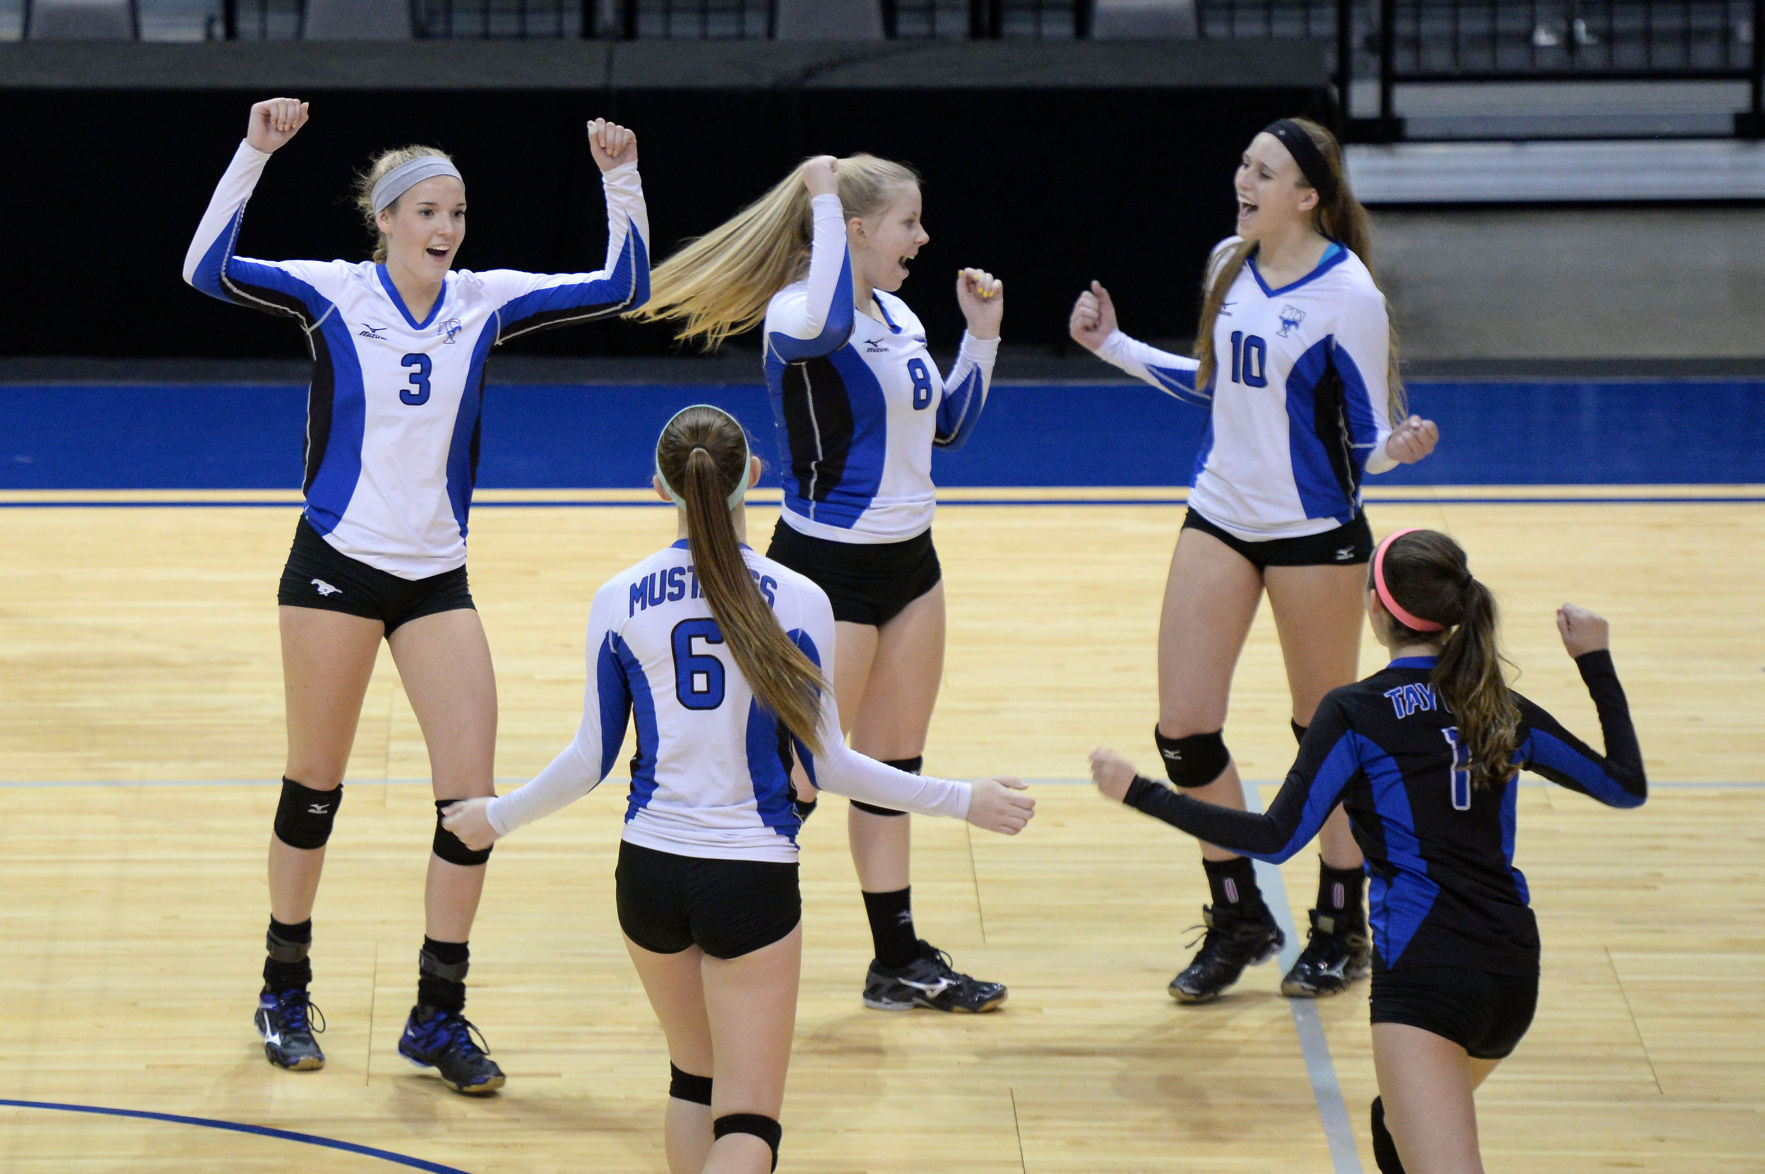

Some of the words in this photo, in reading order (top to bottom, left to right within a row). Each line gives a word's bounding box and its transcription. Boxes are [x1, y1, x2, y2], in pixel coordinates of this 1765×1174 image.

[399, 352, 432, 406] 3
[907, 357, 933, 411] 8
[1230, 330, 1268, 388] 10
[629, 566, 778, 619] MUSTS
[670, 617, 726, 711] 6
[1441, 726, 1472, 811] 1
